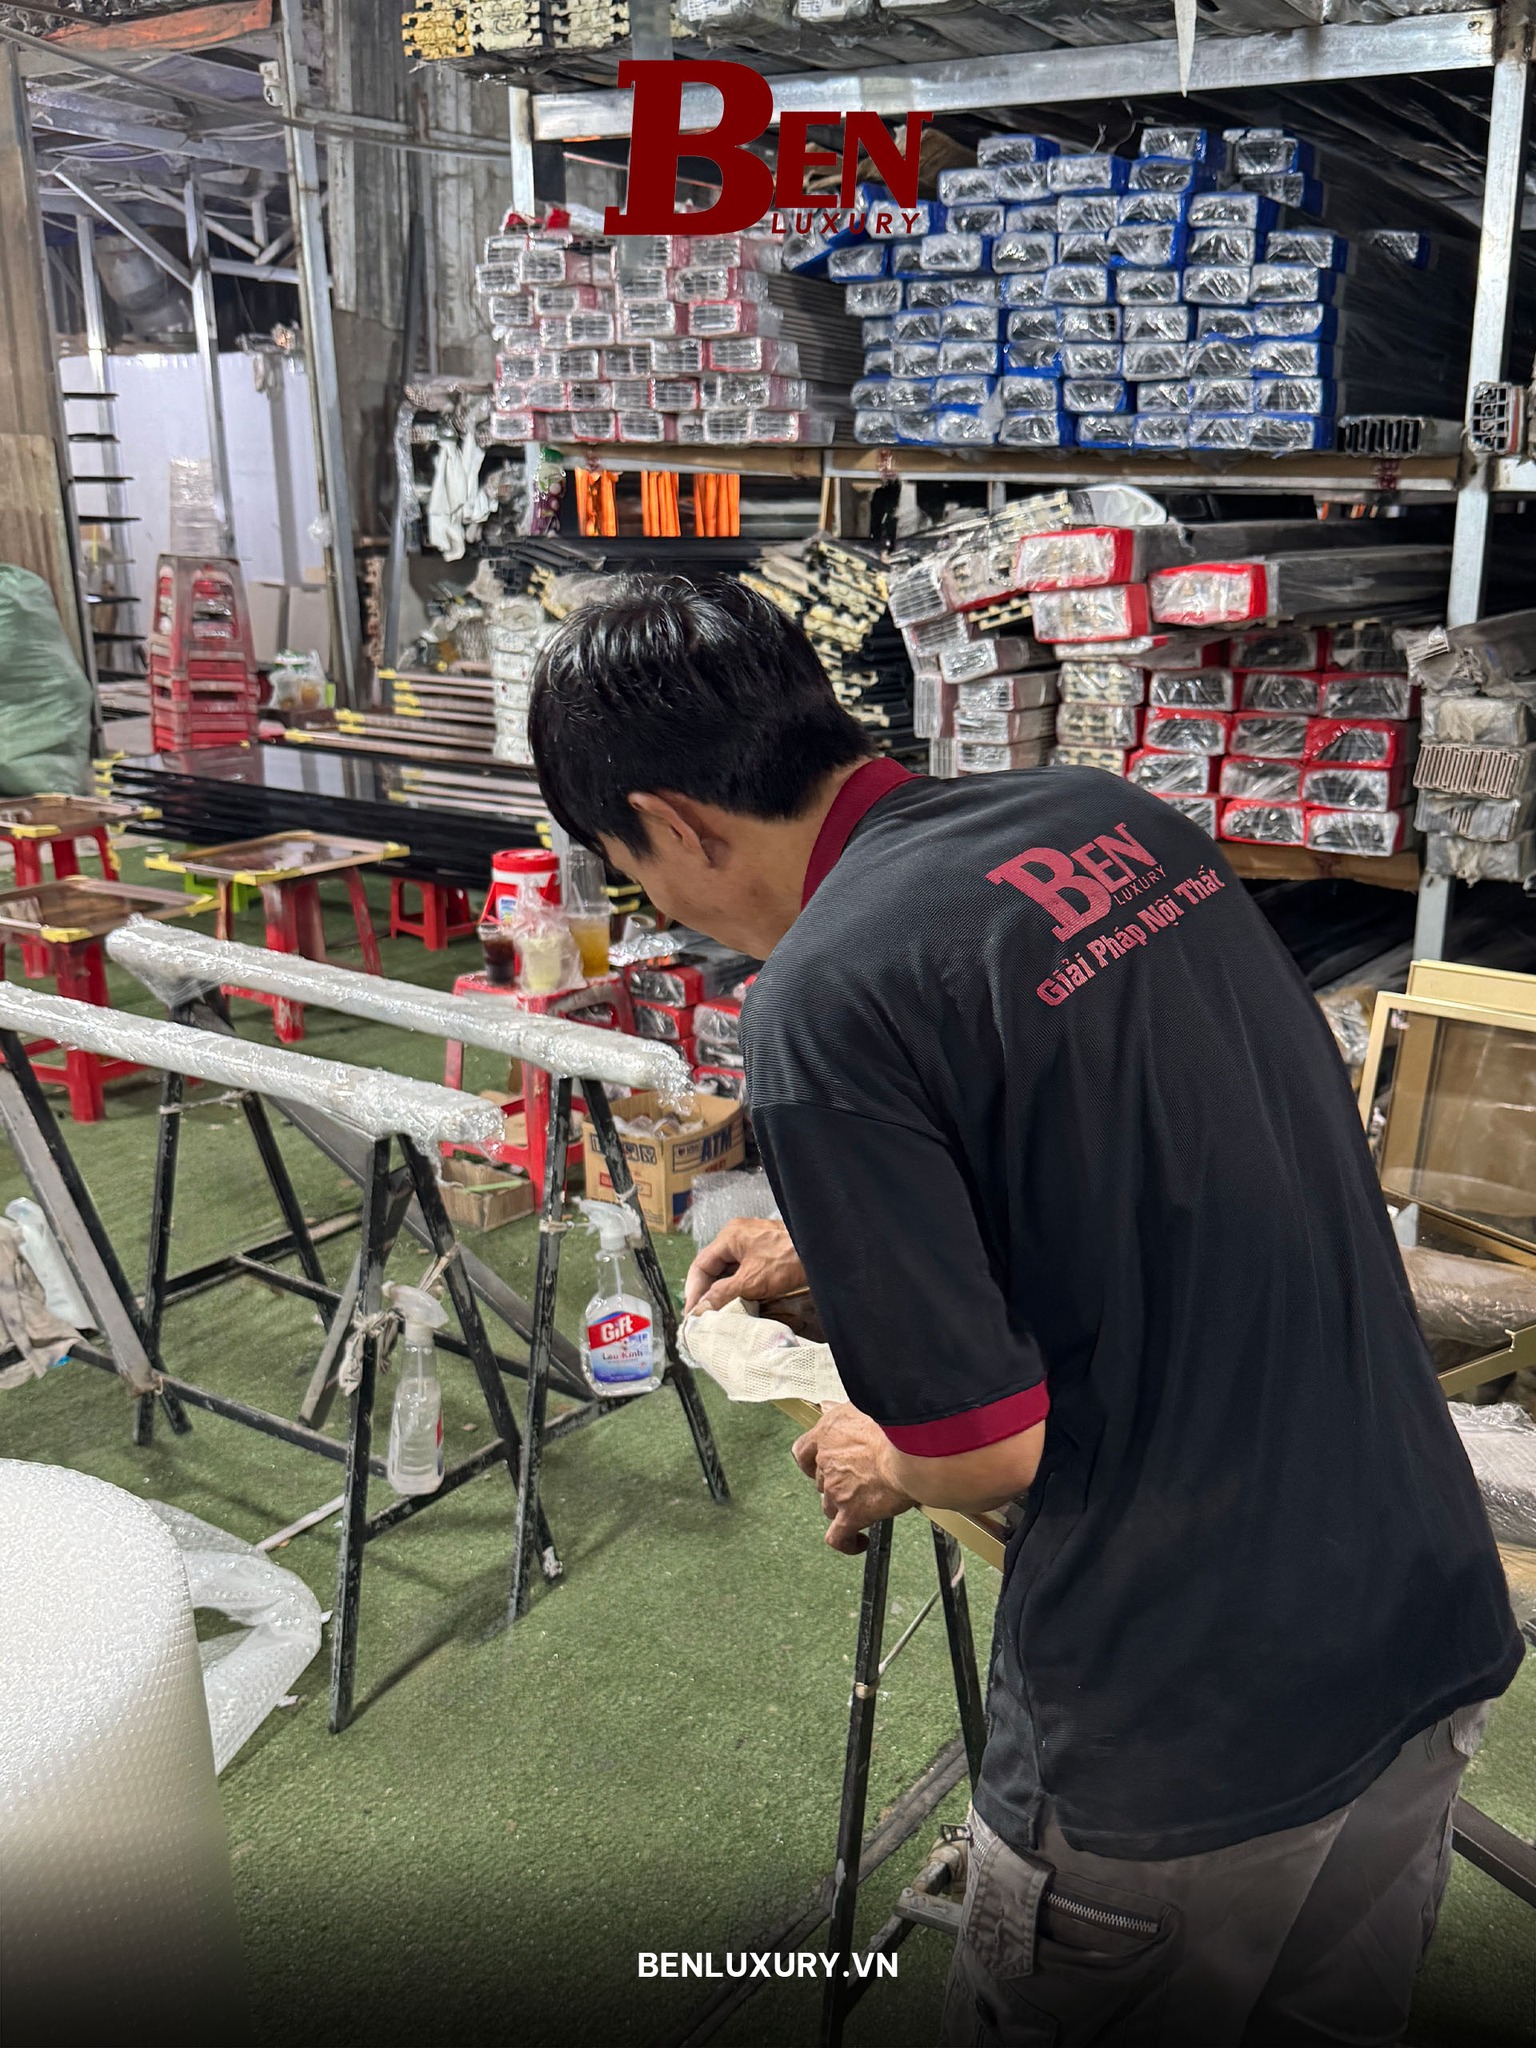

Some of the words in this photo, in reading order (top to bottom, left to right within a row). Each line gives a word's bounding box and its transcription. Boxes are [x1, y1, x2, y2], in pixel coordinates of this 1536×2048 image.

[985, 822, 1156, 942] BEN
[1114, 865, 1167, 905] LUXURY
[1036, 952, 1096, 1006] Giải
[1087, 925, 1147, 968] Pháp
[1137, 894, 1184, 933] Nội
[1174, 864, 1225, 905] Thất
[601, 1314, 634, 1342] Gift
